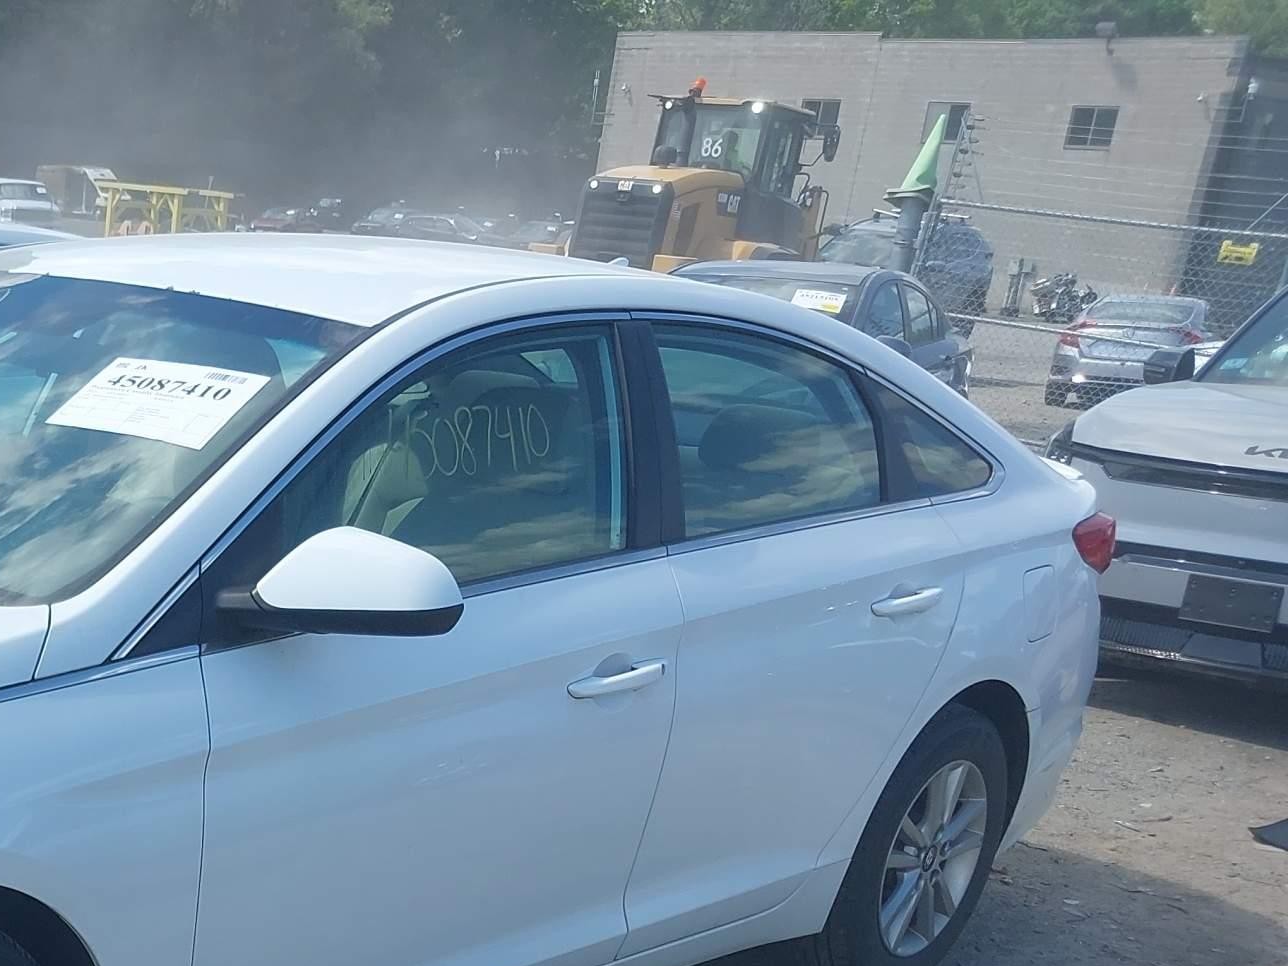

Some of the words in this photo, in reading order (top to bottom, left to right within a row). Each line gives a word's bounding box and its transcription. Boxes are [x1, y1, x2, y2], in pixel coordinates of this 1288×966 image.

[701, 137, 724, 158] 86
[617, 179, 634, 191] CAT
[726, 193, 742, 213] CAT
[107, 373, 233, 401] 45087410
